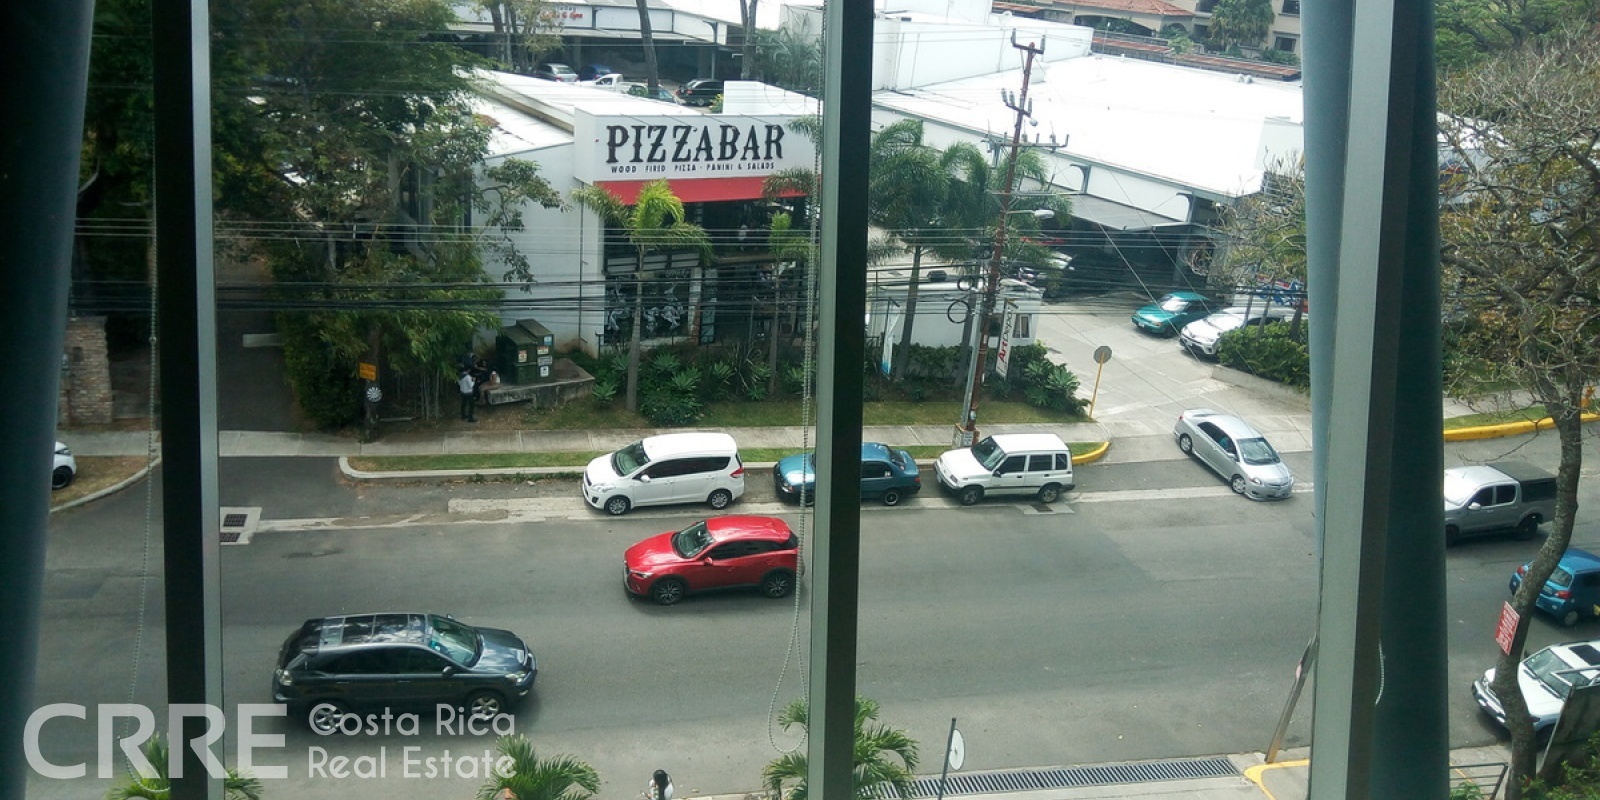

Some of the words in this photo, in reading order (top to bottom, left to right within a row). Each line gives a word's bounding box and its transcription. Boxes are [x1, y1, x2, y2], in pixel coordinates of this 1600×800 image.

[606, 124, 785, 164] PIZZABAR
[611, 165, 637, 174] WOOD
[645, 164, 666, 173] FIRED
[674, 164, 697, 172] PIZZA
[706, 163, 733, 171] PANINI
[747, 161, 774, 170] SALADS
